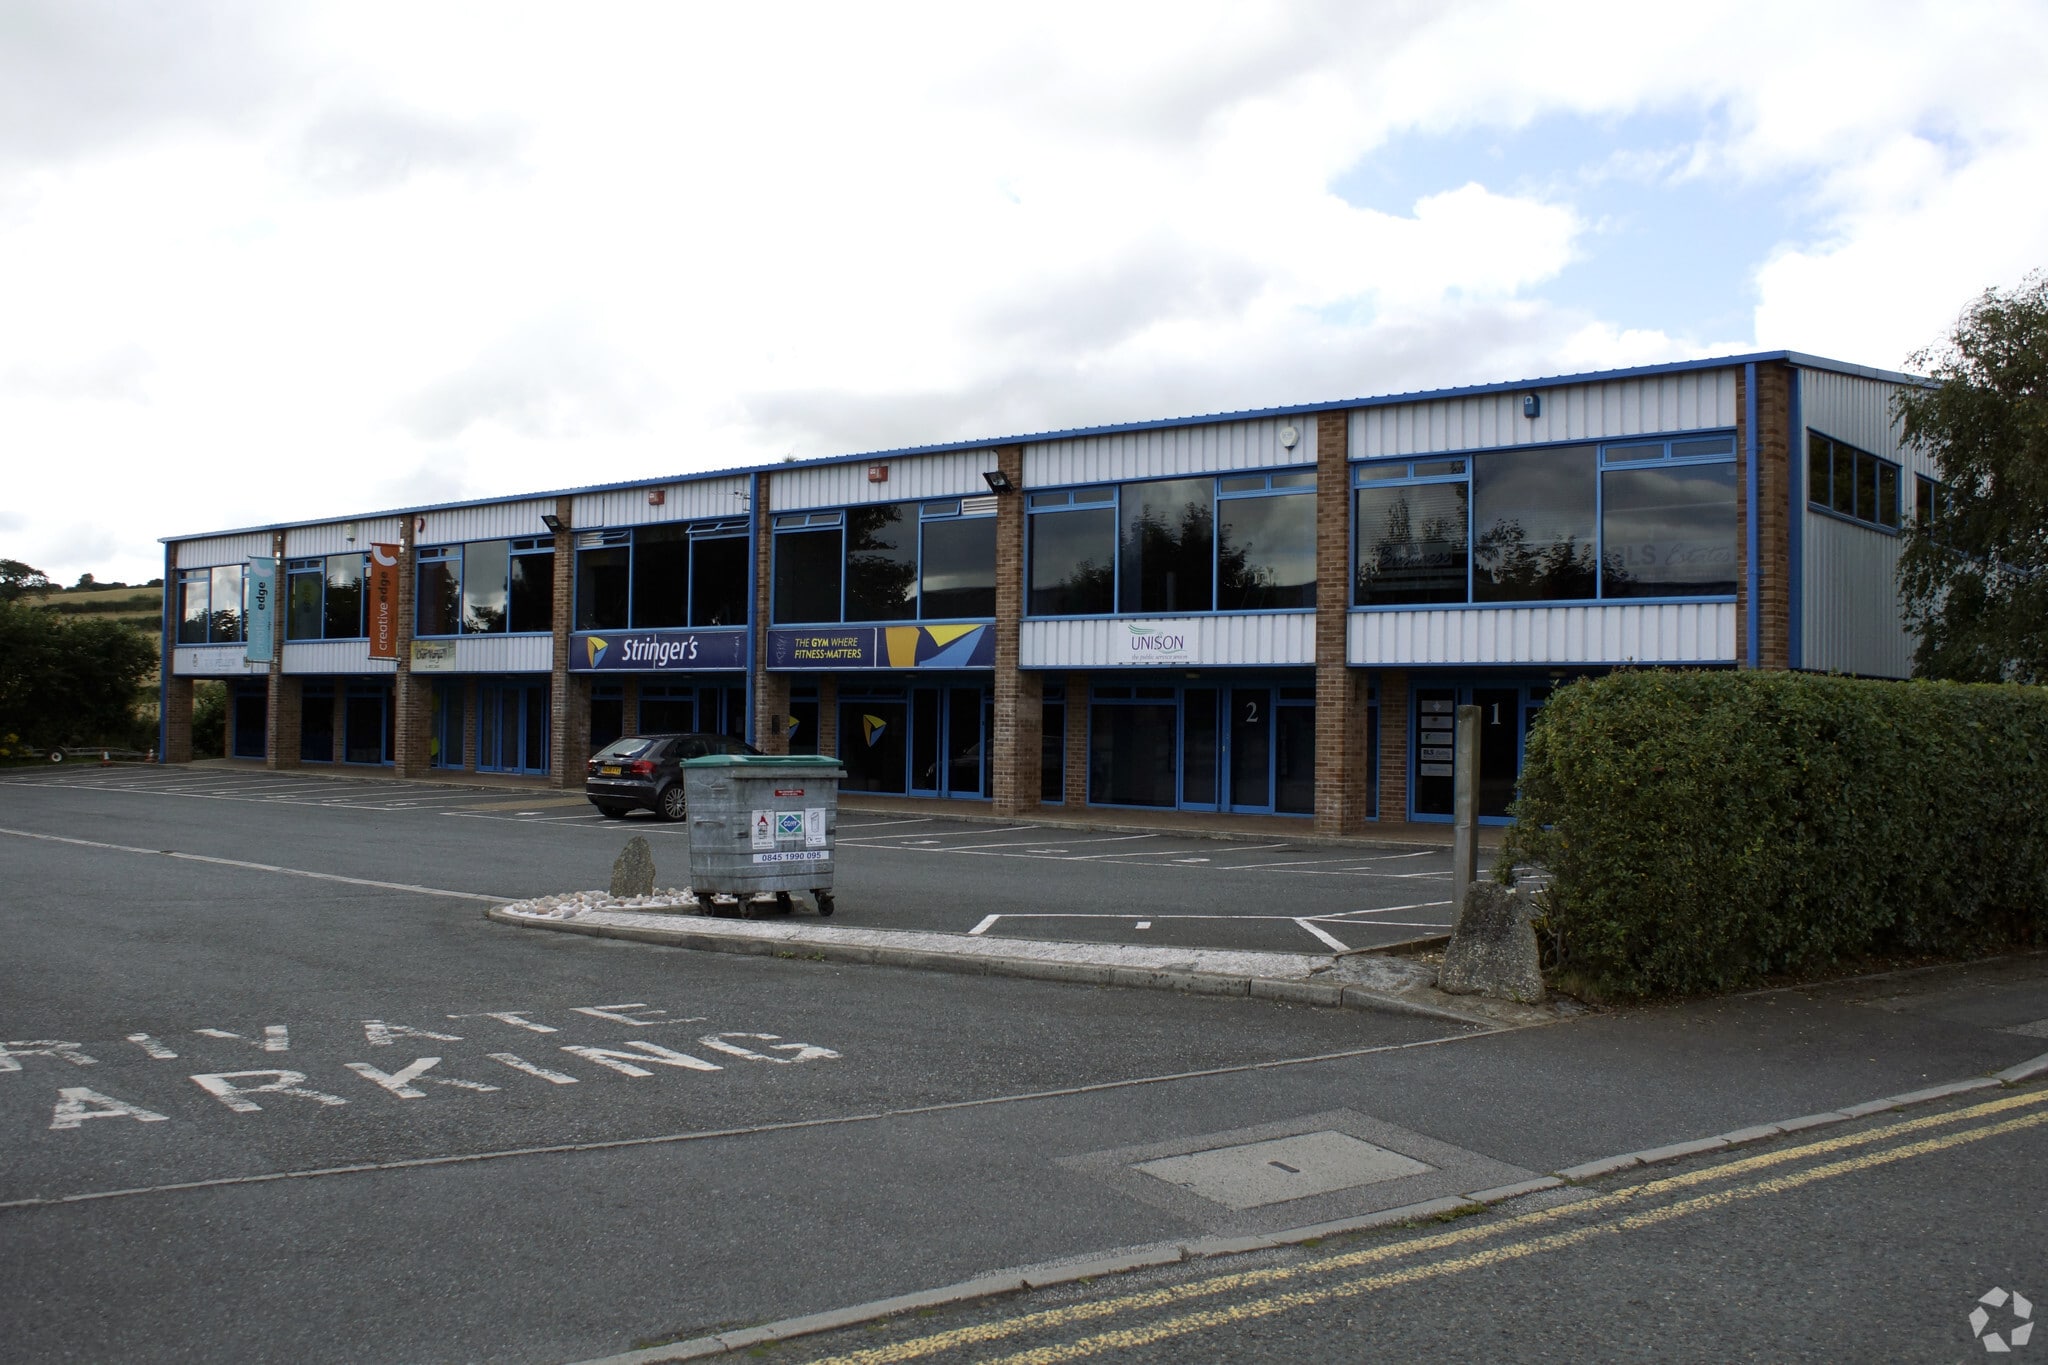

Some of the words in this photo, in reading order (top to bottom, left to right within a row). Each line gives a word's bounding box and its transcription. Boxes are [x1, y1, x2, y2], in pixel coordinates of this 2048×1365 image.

[622, 635, 698, 667] Stringer's
[795, 638, 810, 648] THE
[811, 638, 829, 648] GYM
[831, 637, 859, 647] WHERE
[1131, 635, 1184, 651] UNISON
[1246, 701, 1258, 723] 2
[1491, 703, 1501, 725] 1
[762, 854, 783, 862] 0845
